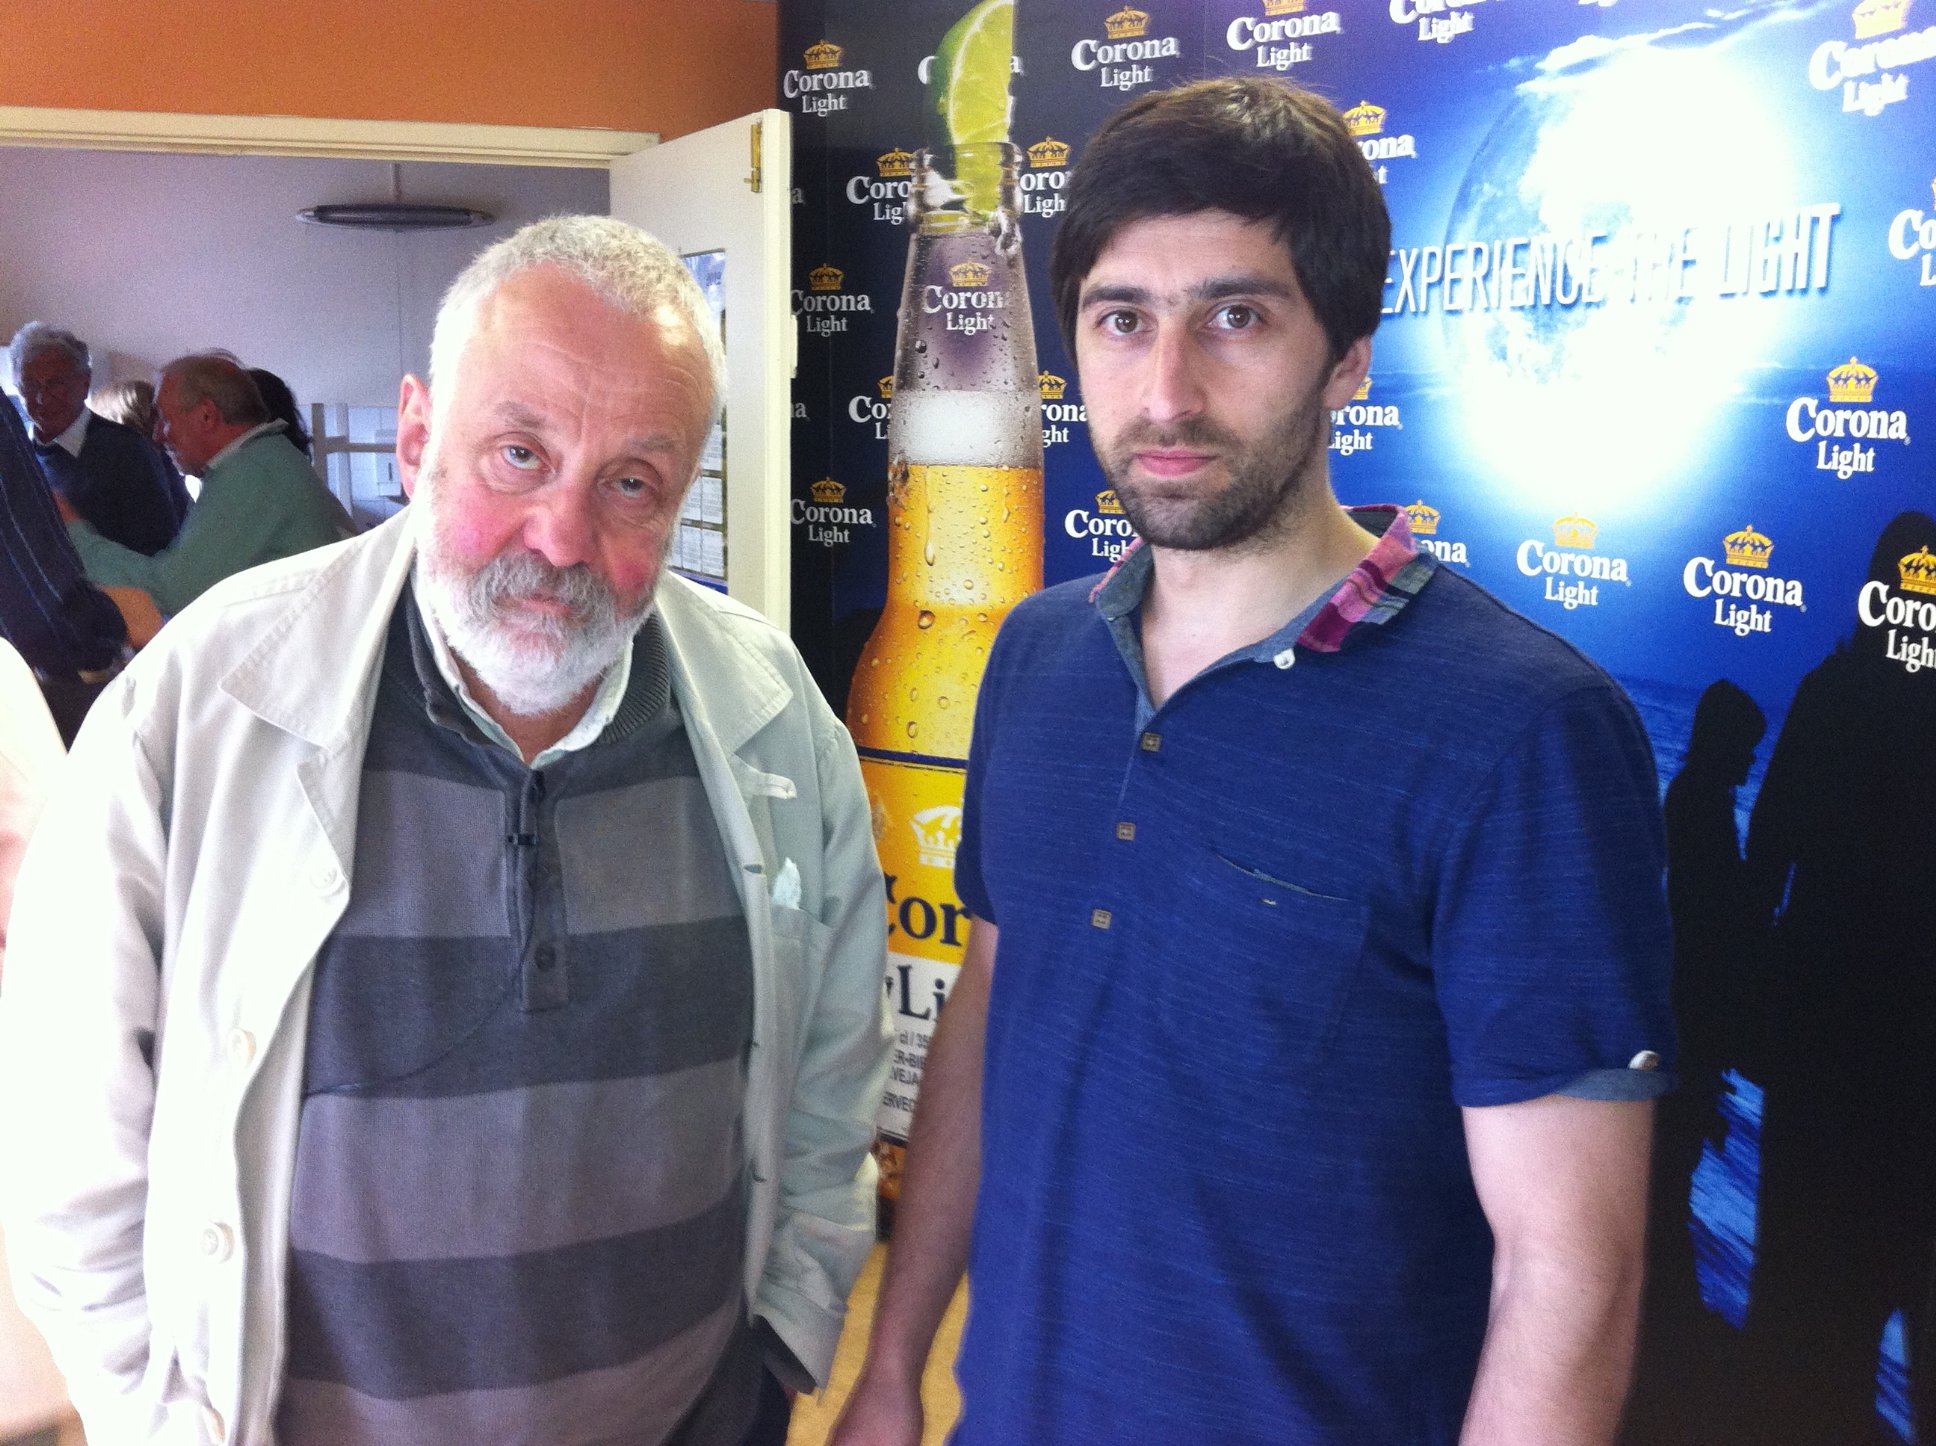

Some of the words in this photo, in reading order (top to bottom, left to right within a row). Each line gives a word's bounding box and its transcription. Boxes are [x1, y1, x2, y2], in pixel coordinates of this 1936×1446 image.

[1226, 11, 1341, 51] Corona
[1418, 11, 1475, 44] Light
[1071, 36, 1178, 71] Corona
[1256, 42, 1312, 71] Light
[783, 69, 870, 99] Corona
[1100, 64, 1153, 91] Light
[802, 93, 848, 117] Light
[1357, 134, 1416, 161] ona
[846, 176, 910, 204] Coro
[1020, 170, 1072, 191] oro
[873, 202, 907, 226] Lig
[1023, 194, 1067, 218] Ligh
[923, 285, 1003, 314] Coron
[806, 315, 848, 337] Light
[946, 312, 995, 335] Light
[1330, 404, 1400, 427] rona
[1786, 396, 1908, 442] Corona
[1042, 425, 1069, 447] ght
[1328, 429, 1373, 456] ight
[1816, 440, 1876, 480] Light
[808, 525, 850, 548] Light
[1064, 509, 1138, 539] Coro
[1516, 539, 1628, 582] Corona
[1544, 576, 1599, 610] Light
[1683, 556, 1804, 607] Corona
[1714, 598, 1773, 637] Light
[1858, 580, 1936, 632] Coro
[1886, 629, 1936, 673] Ligh
